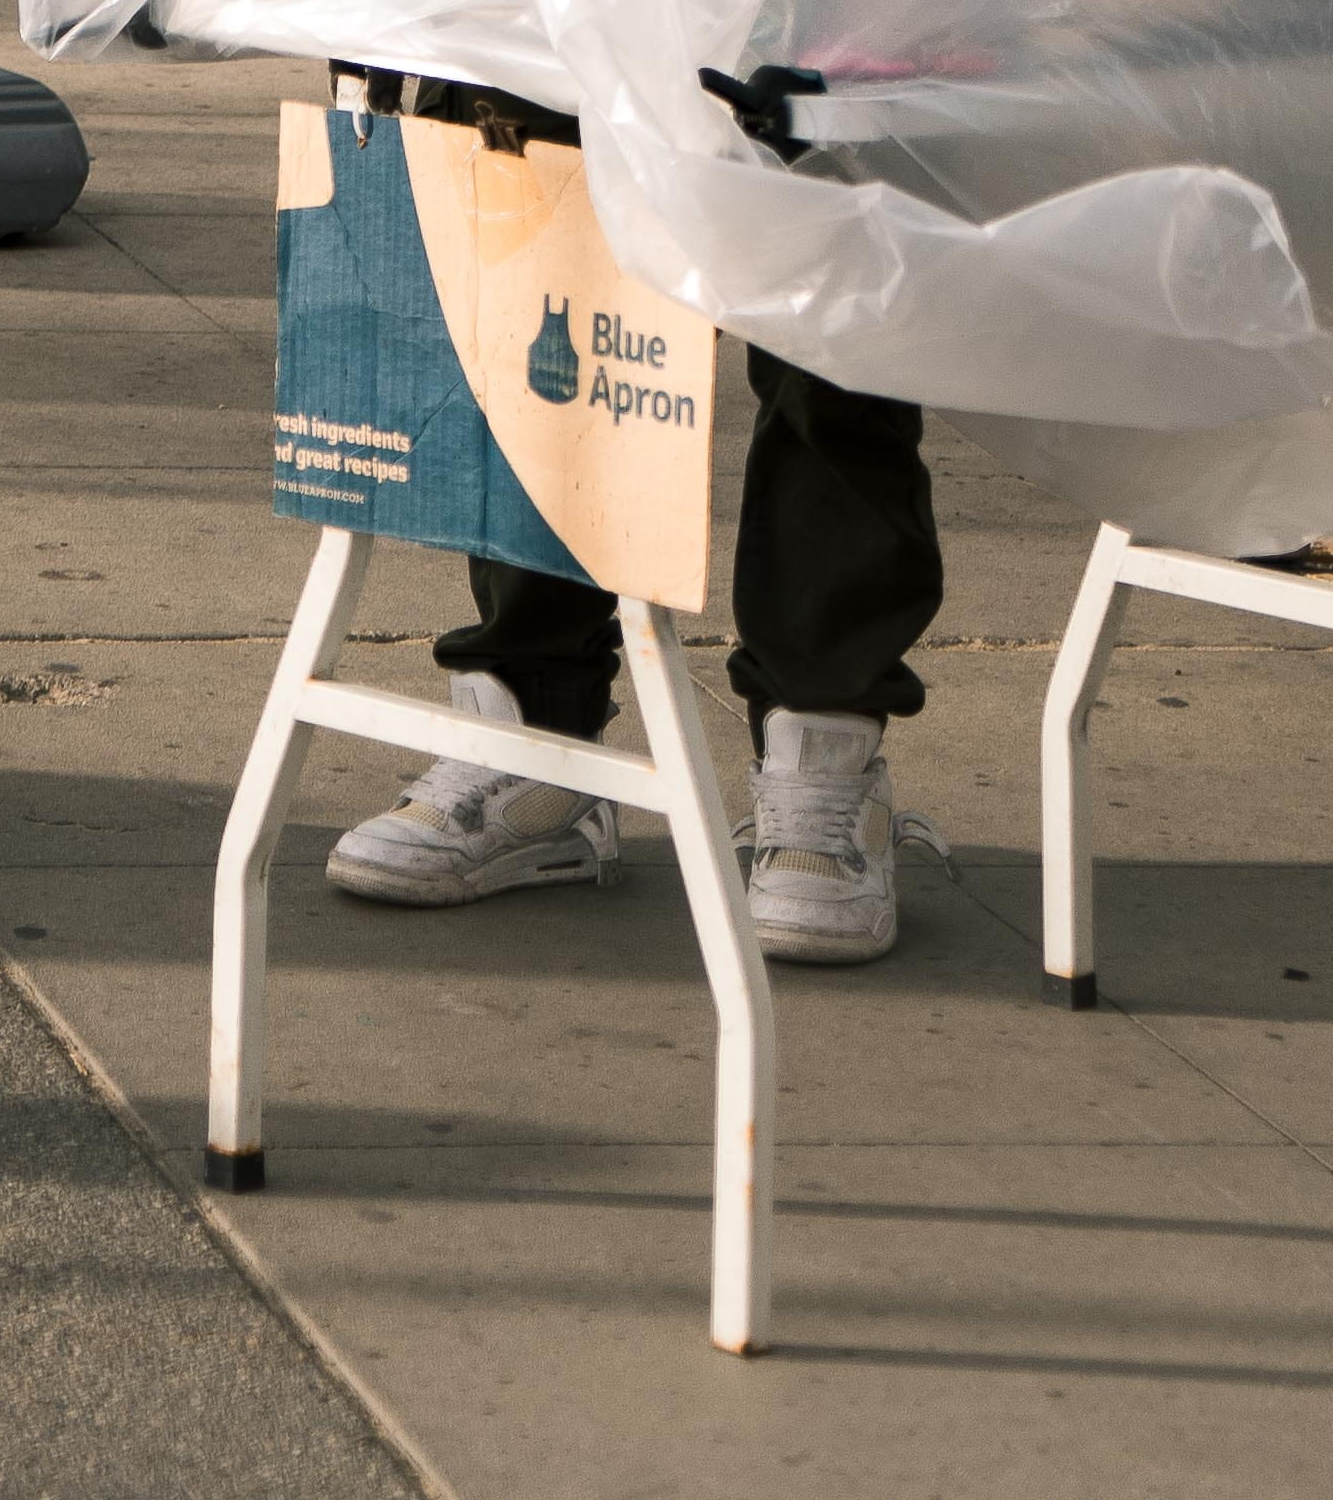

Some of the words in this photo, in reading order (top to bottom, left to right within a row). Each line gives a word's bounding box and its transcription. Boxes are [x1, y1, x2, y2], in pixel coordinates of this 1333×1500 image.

[591, 312, 667, 369] Blue
[588, 365, 695, 428] Apron
[311, 415, 411, 453] ingredients
[295, 448, 342, 471] great
[344, 456, 410, 484] recipes
